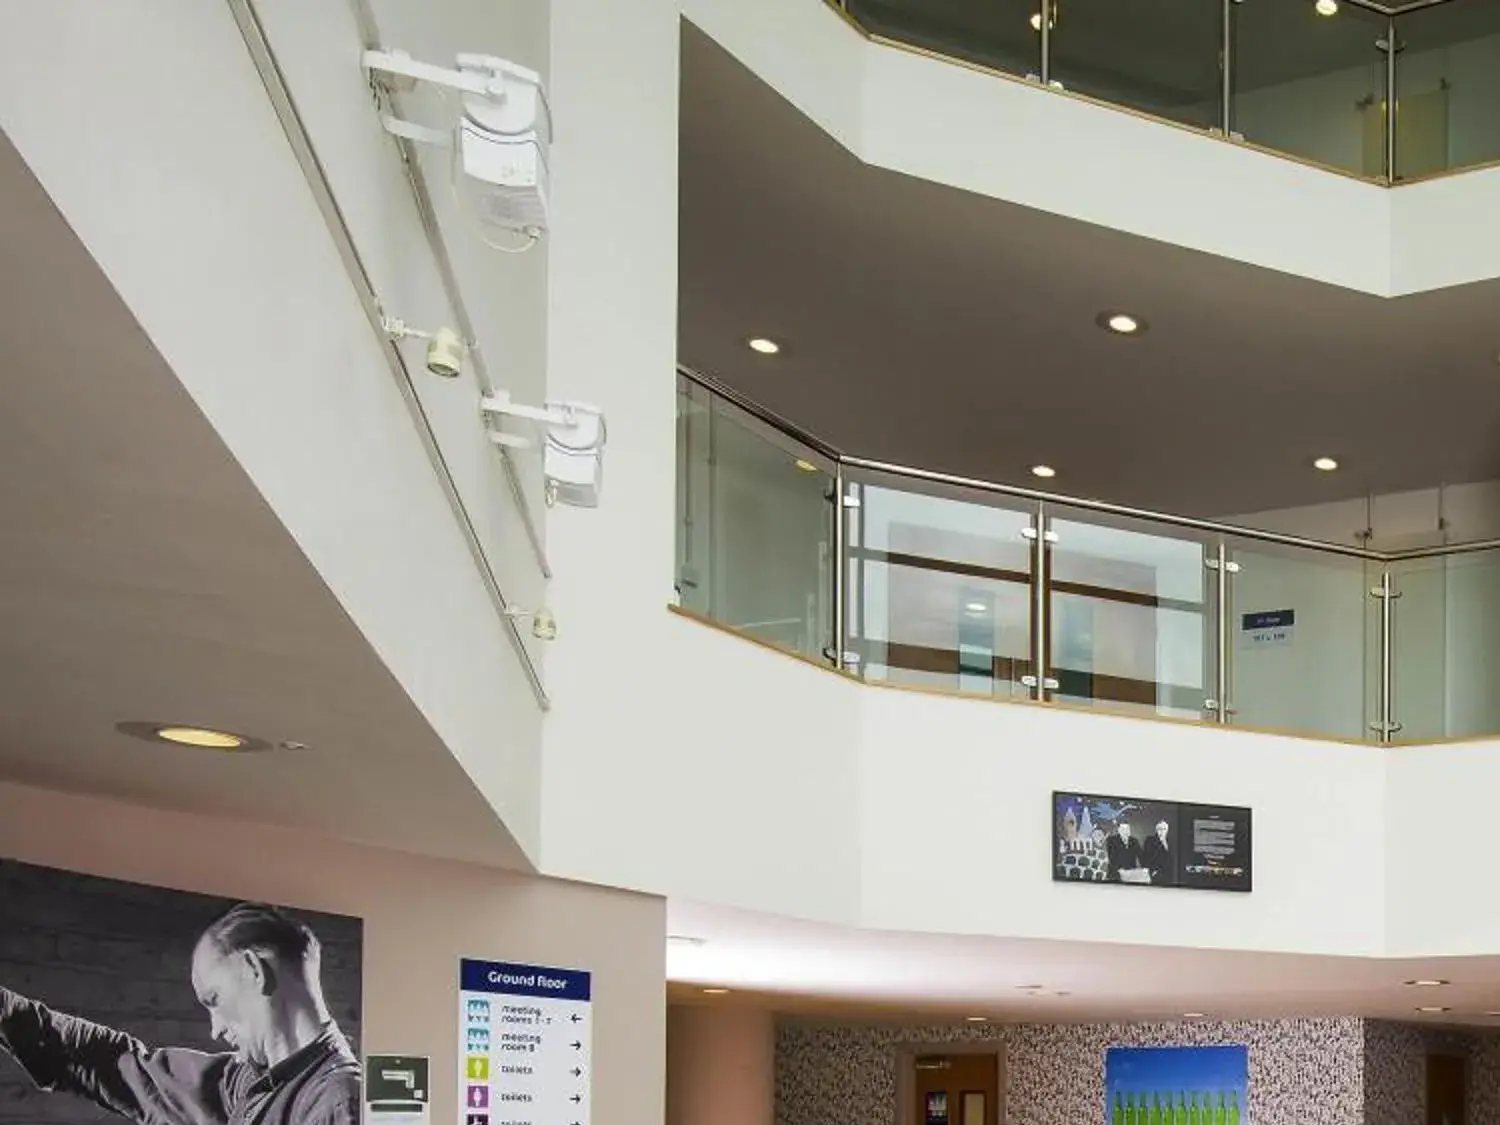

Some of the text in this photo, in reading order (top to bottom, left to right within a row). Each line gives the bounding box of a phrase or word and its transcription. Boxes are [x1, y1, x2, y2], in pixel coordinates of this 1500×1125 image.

[487, 971, 568, 990] Ground floor
[502, 1004, 542, 1017] meeting
[502, 1032, 542, 1045] meeting
